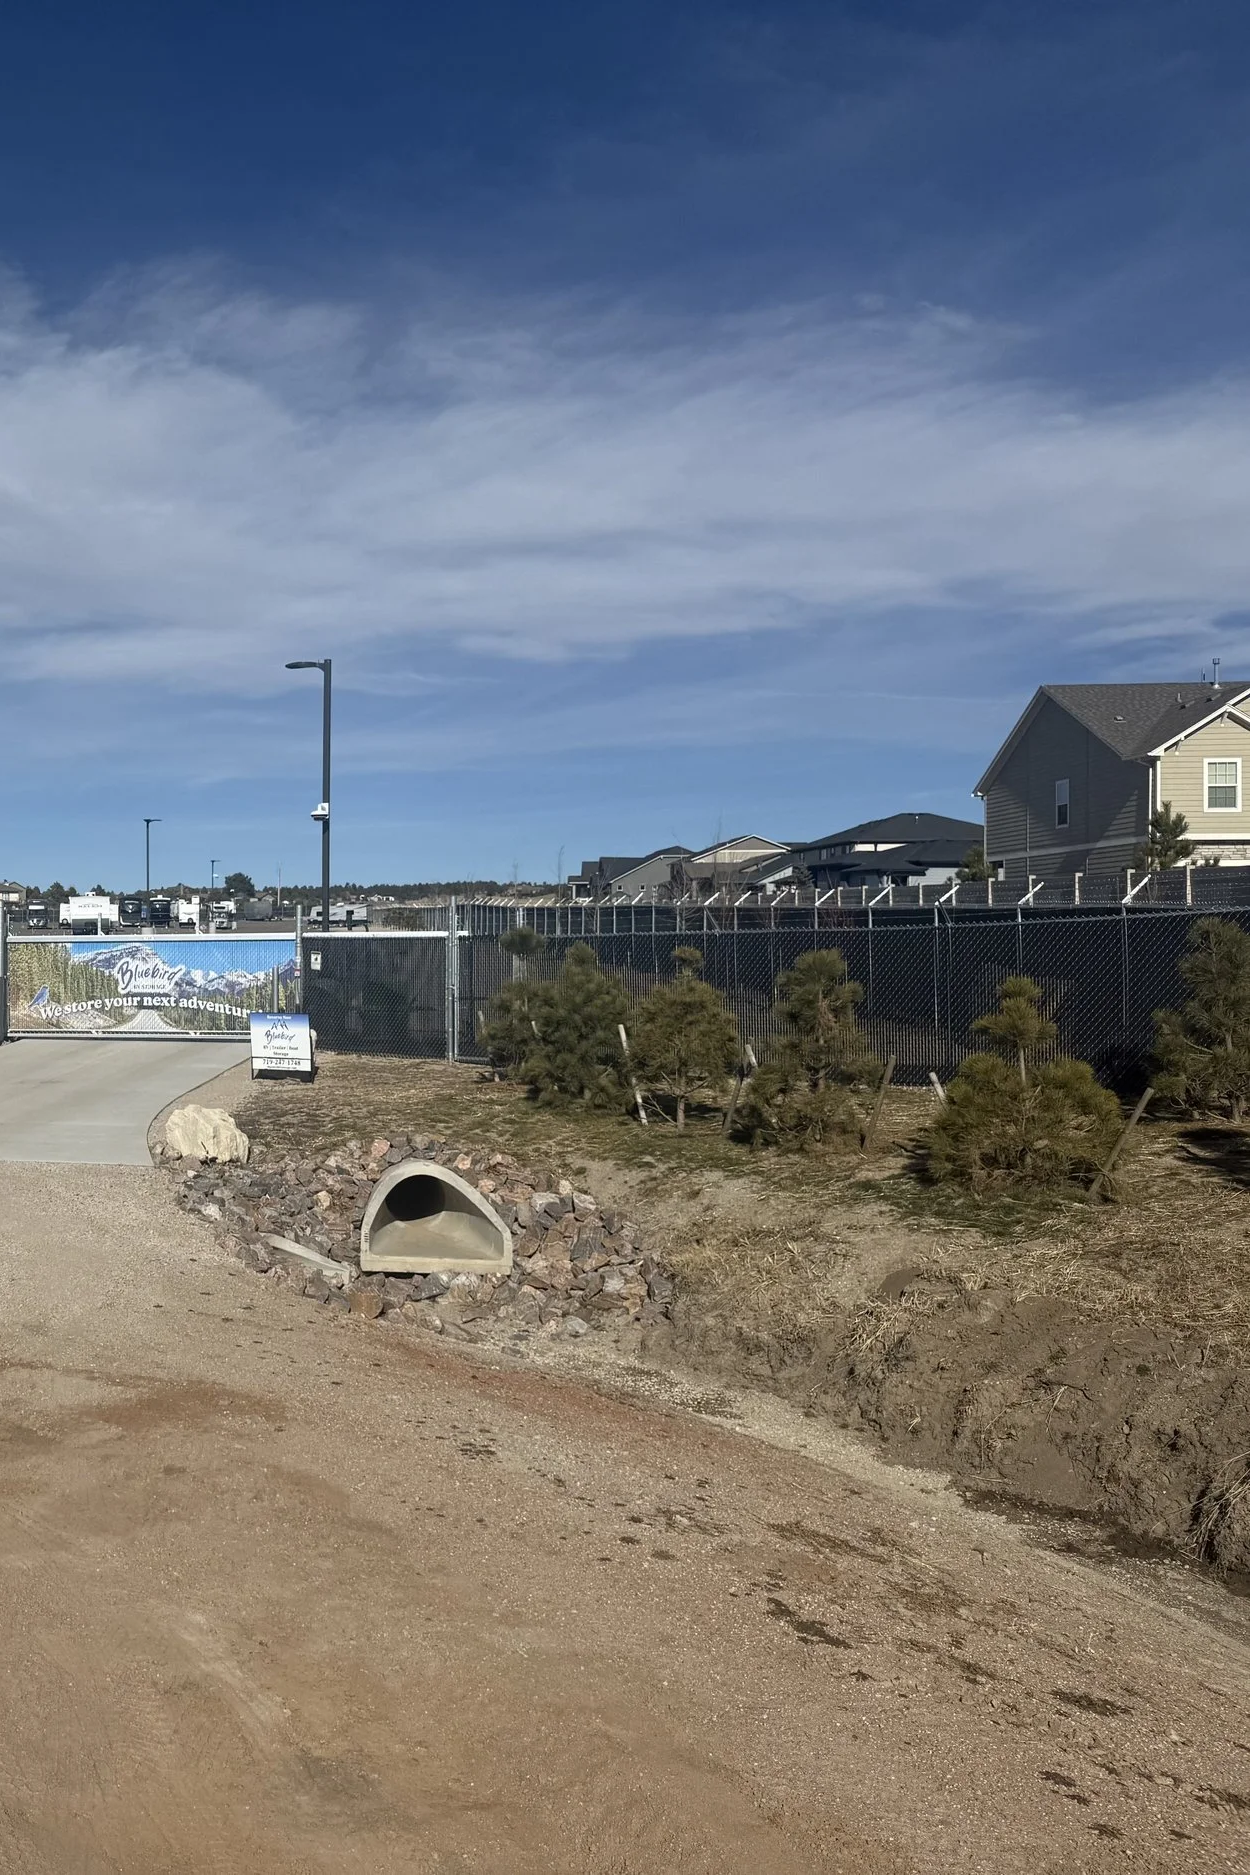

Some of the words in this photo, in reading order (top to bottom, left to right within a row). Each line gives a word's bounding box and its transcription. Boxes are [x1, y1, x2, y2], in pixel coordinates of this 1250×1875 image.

[117, 961, 182, 990] Bluebird
[39, 1003, 63, 1020] We
[64, 999, 103, 1015] store
[104, 996, 141, 1011] your
[143, 995, 177, 1007] next
[179, 996, 263, 1018] adventur
[264, 1029, 296, 1045] Bluebird
